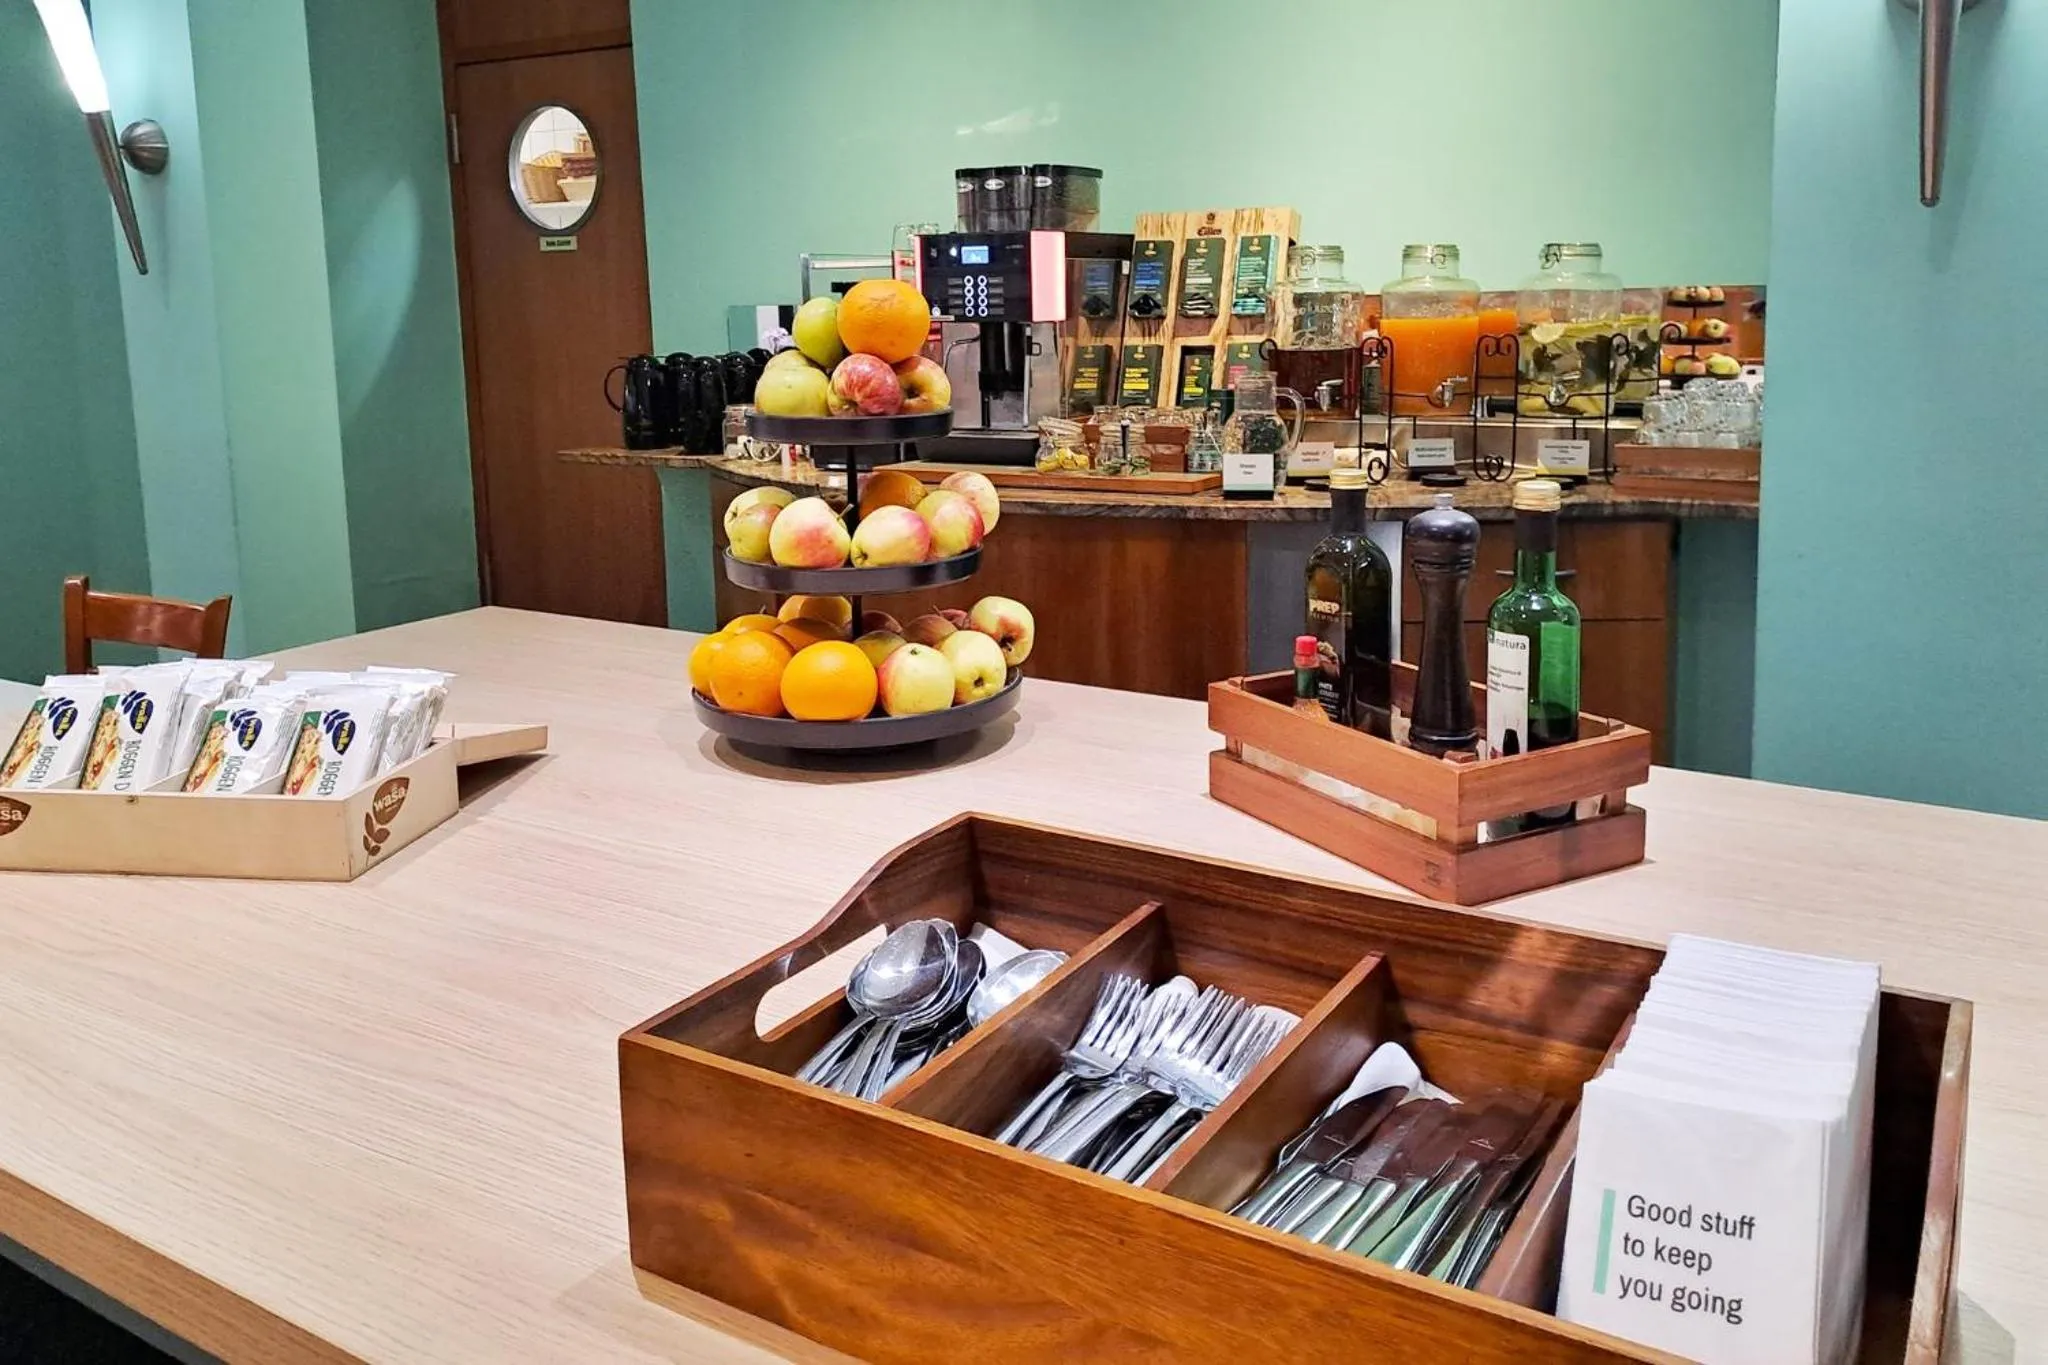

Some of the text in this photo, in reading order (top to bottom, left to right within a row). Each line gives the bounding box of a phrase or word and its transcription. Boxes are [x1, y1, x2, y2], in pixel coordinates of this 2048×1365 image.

[0, 809, 24, 821] sa
[1626, 1194, 1756, 1241] Good stuff
[1622, 1232, 1713, 1276] to keep
[1617, 1274, 1744, 1326] you going
